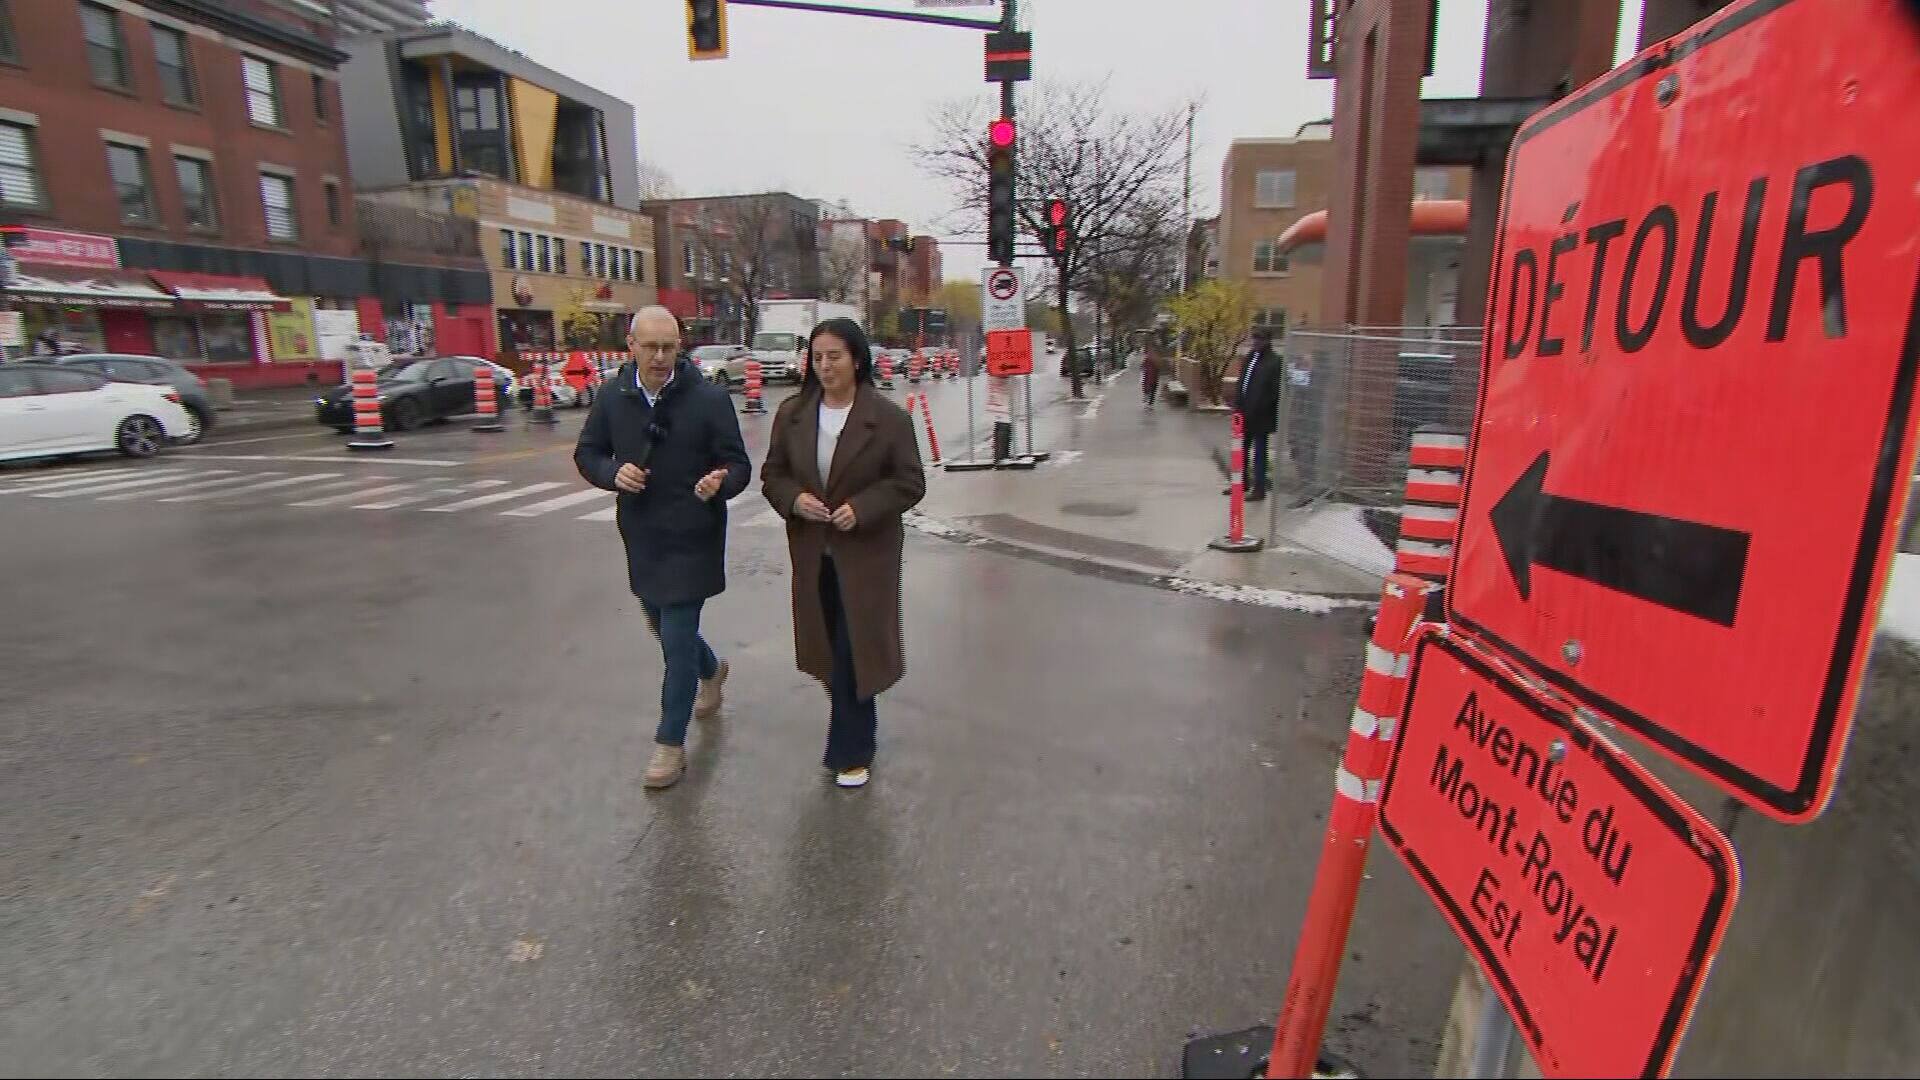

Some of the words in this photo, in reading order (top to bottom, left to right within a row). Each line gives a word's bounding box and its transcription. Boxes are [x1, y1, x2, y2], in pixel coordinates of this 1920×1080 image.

[1502, 155, 1875, 359] DÉTOUR
[1430, 744, 1617, 983] Mont-Royal
[1455, 690, 1578, 824] Avenue
[1582, 805, 1633, 886] du
[1471, 867, 1522, 957] Est
